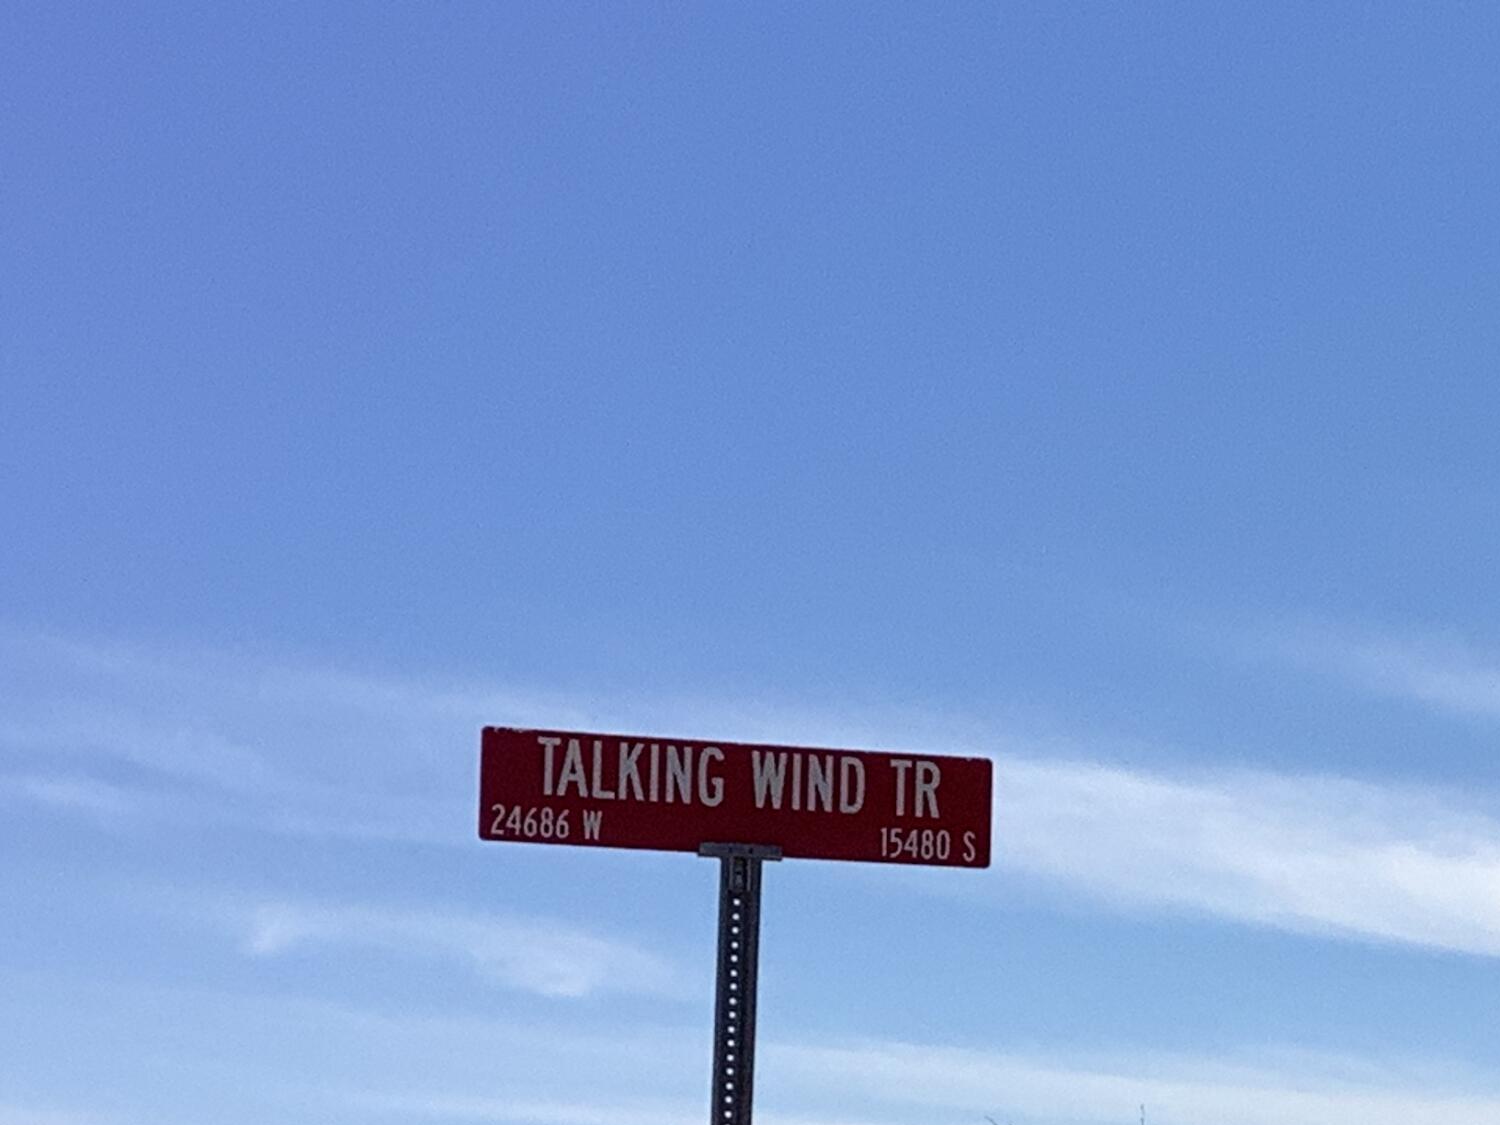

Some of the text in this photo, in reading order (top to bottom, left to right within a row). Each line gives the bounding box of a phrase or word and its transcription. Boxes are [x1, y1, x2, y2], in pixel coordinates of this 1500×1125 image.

[538, 736, 941, 819] TALKING WIND TR
[490, 804, 603, 841] 24686 W
[880, 827, 976, 862] 15480 S
